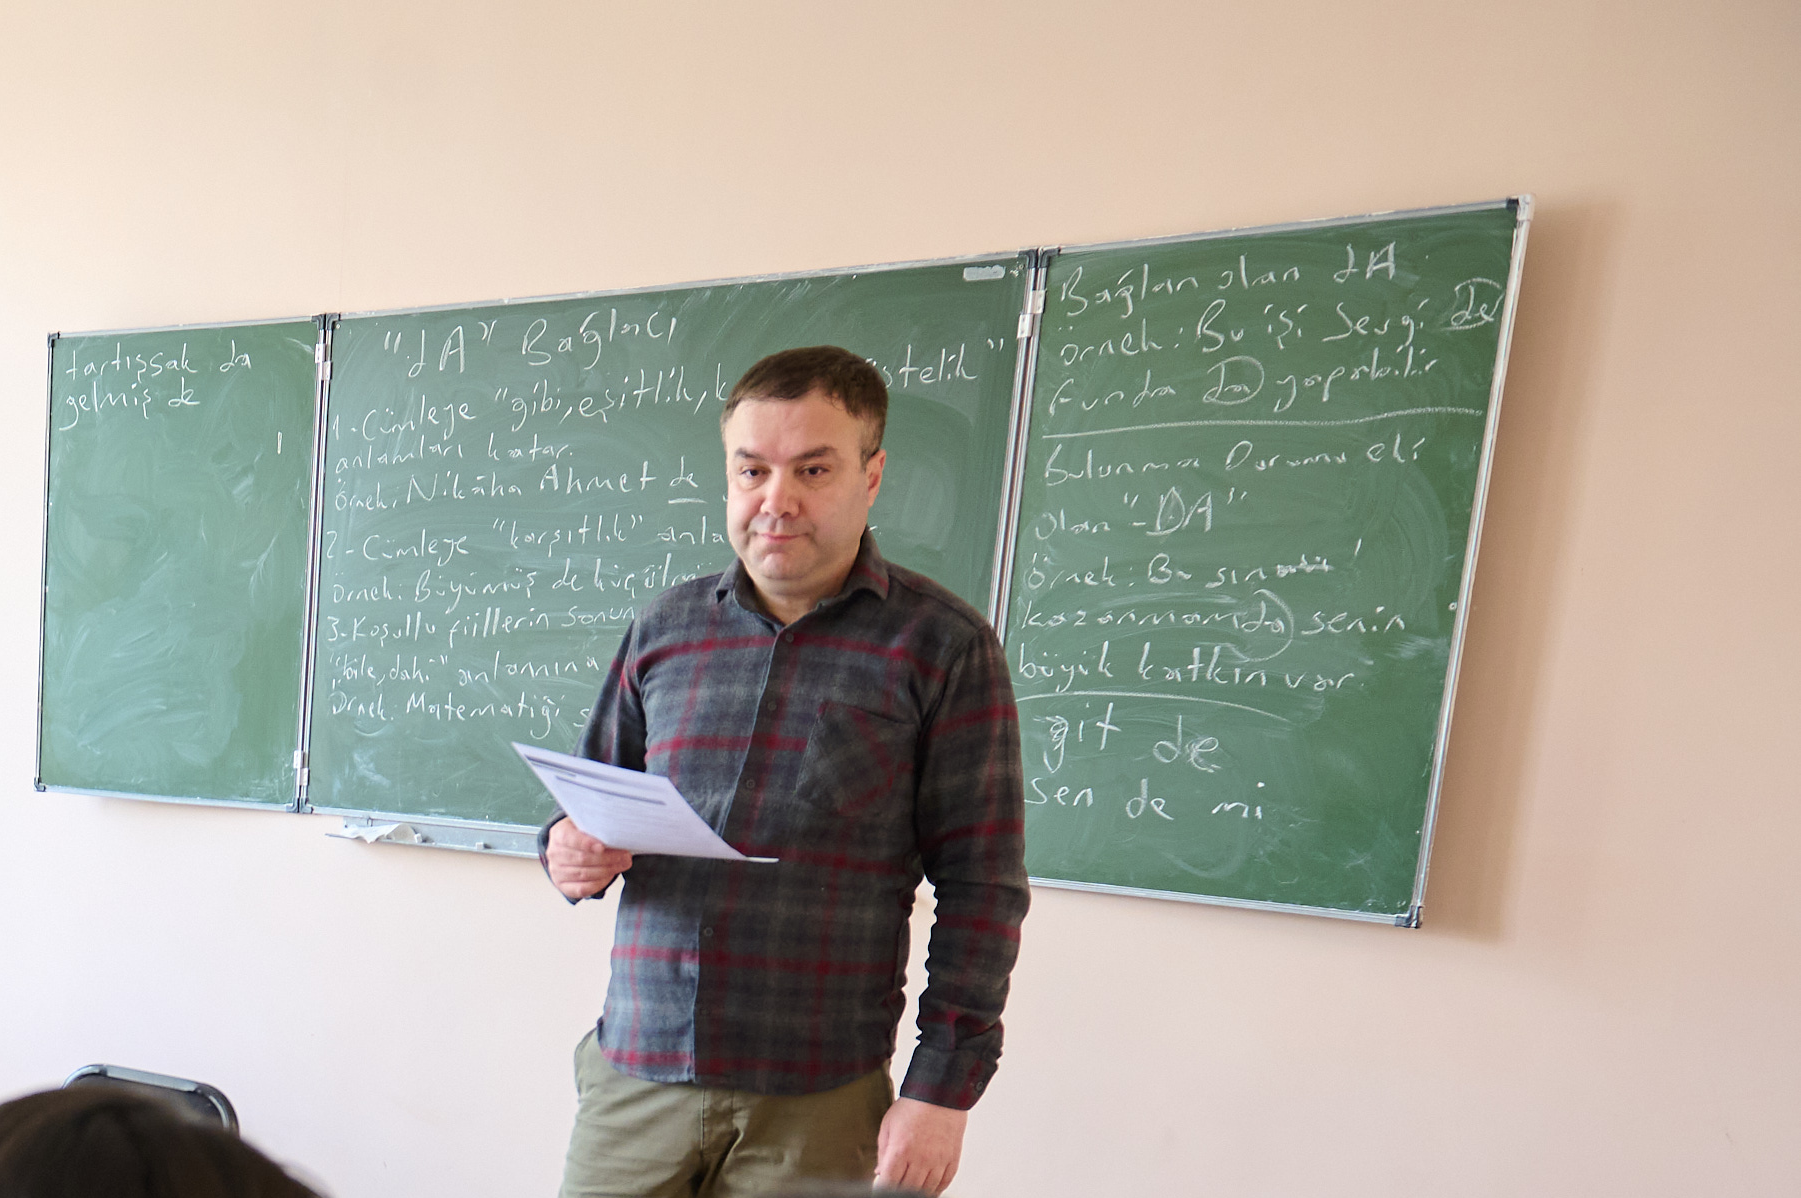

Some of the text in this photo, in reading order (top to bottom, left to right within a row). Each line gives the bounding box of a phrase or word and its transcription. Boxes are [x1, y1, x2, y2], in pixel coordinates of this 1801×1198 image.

[1197, 298, 1245, 353] Bu
[539, 460, 657, 495] Ahmet
[669, 455, 699, 488] de
[1125, 777, 1175, 819] de
